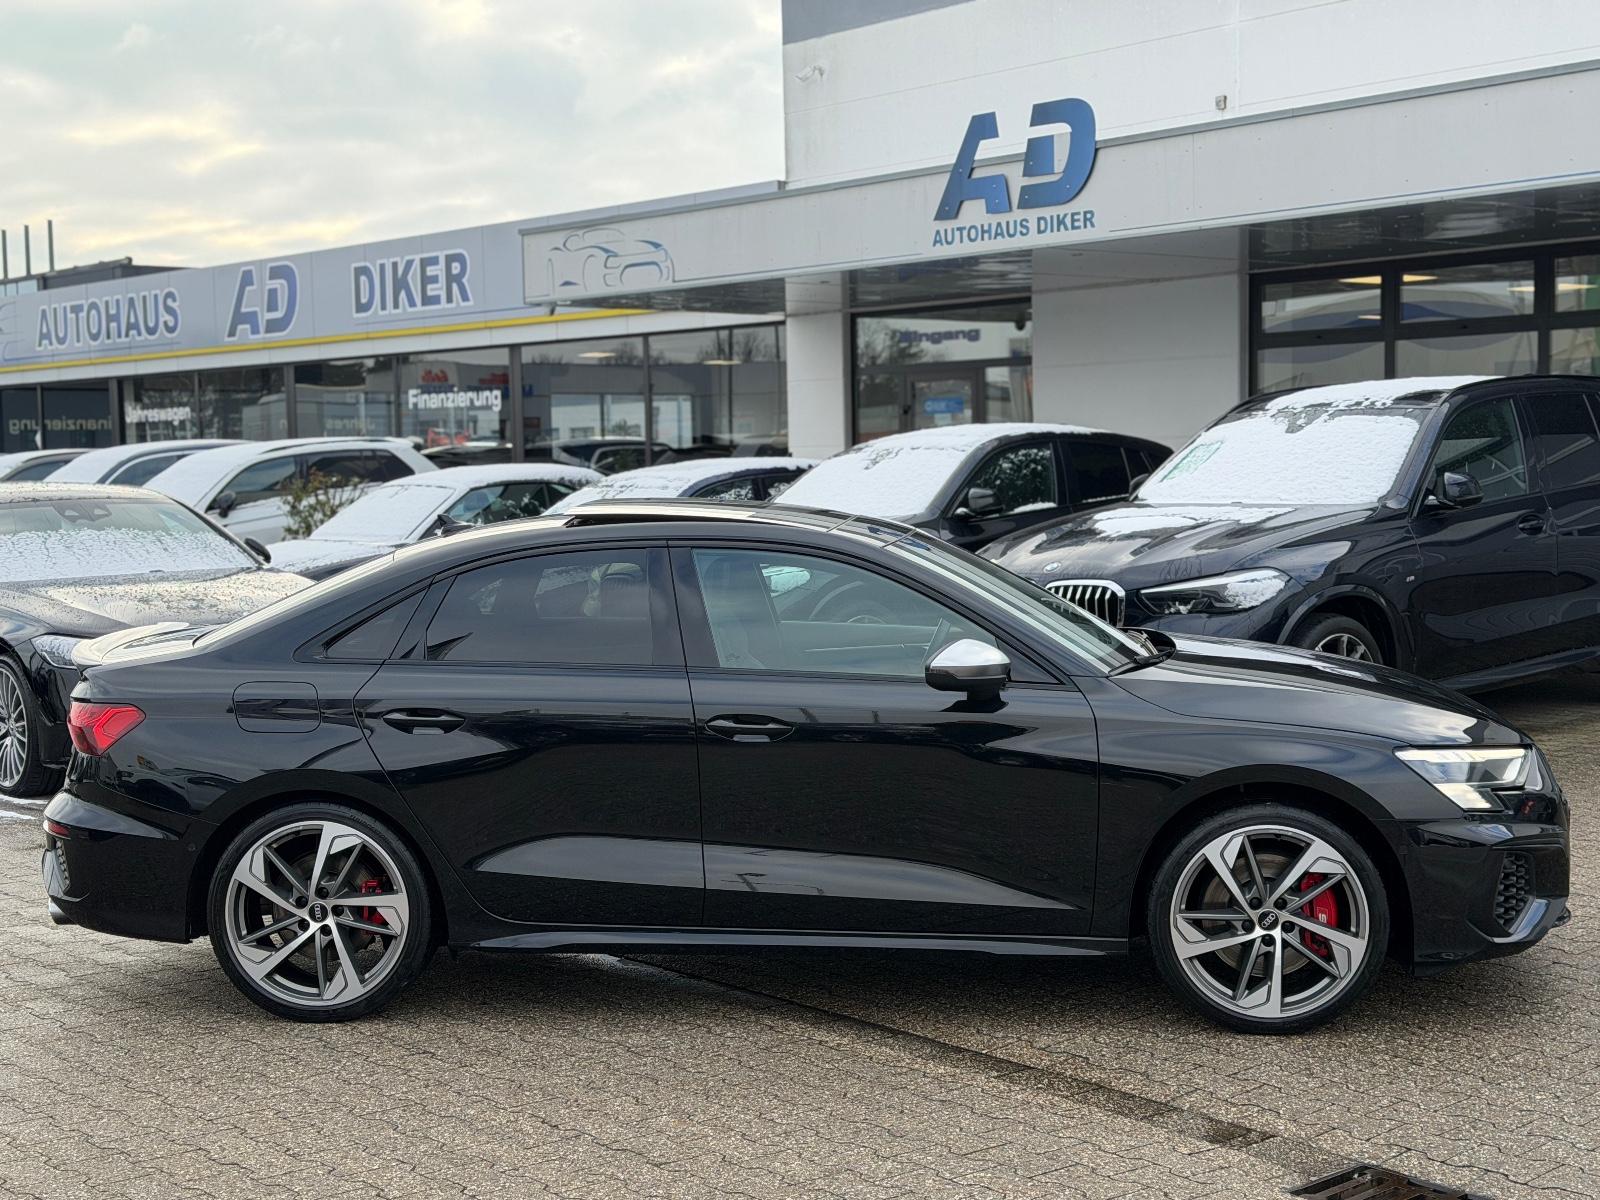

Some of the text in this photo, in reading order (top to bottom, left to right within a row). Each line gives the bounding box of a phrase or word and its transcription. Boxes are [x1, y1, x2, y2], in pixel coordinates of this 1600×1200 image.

[933, 97, 1096, 221] AD
[932, 209, 1096, 247] AUTOHAUS DIKER
[37, 250, 472, 349] AUTOHAUS AD DIKER
[125, 404, 191, 426] Jahreswagen
[408, 386, 502, 412] Finanzierung
